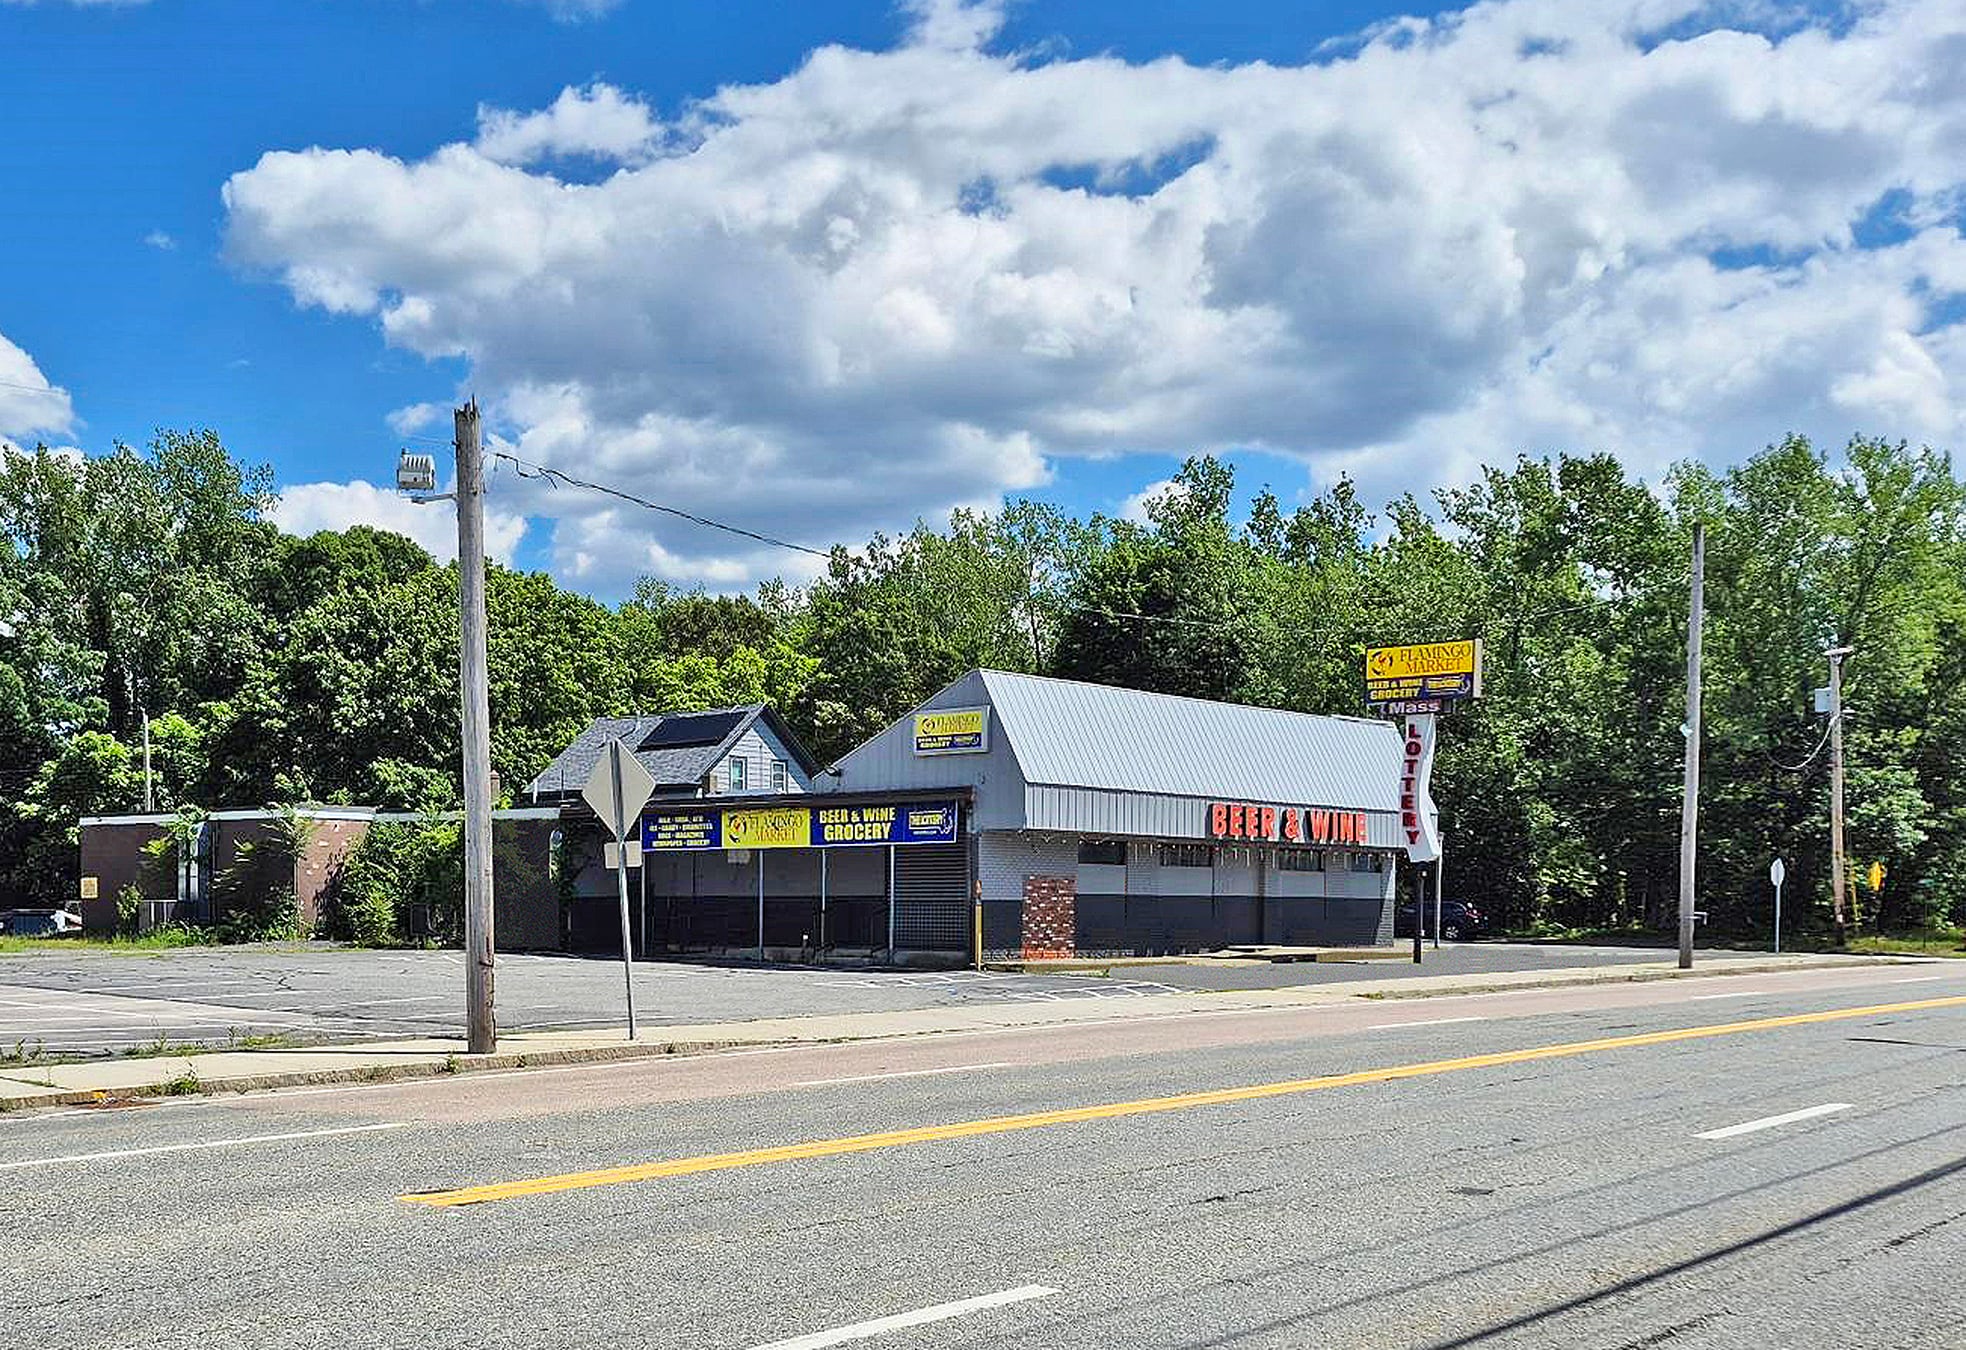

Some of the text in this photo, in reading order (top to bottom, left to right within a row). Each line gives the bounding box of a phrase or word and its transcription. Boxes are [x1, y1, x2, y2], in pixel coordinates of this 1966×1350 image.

[1400, 644, 1471, 662] FLAMINGO
[1405, 658, 1464, 674] MARKET
[1369, 688, 1420, 700] GROCERY
[1389, 701, 1441, 714] Mass
[1400, 723, 1422, 845] LOTTERY
[819, 807, 896, 824] BEER & WINE
[1210, 802, 1369, 843] BEER & WINE
[823, 822, 892, 842] GROCERY
